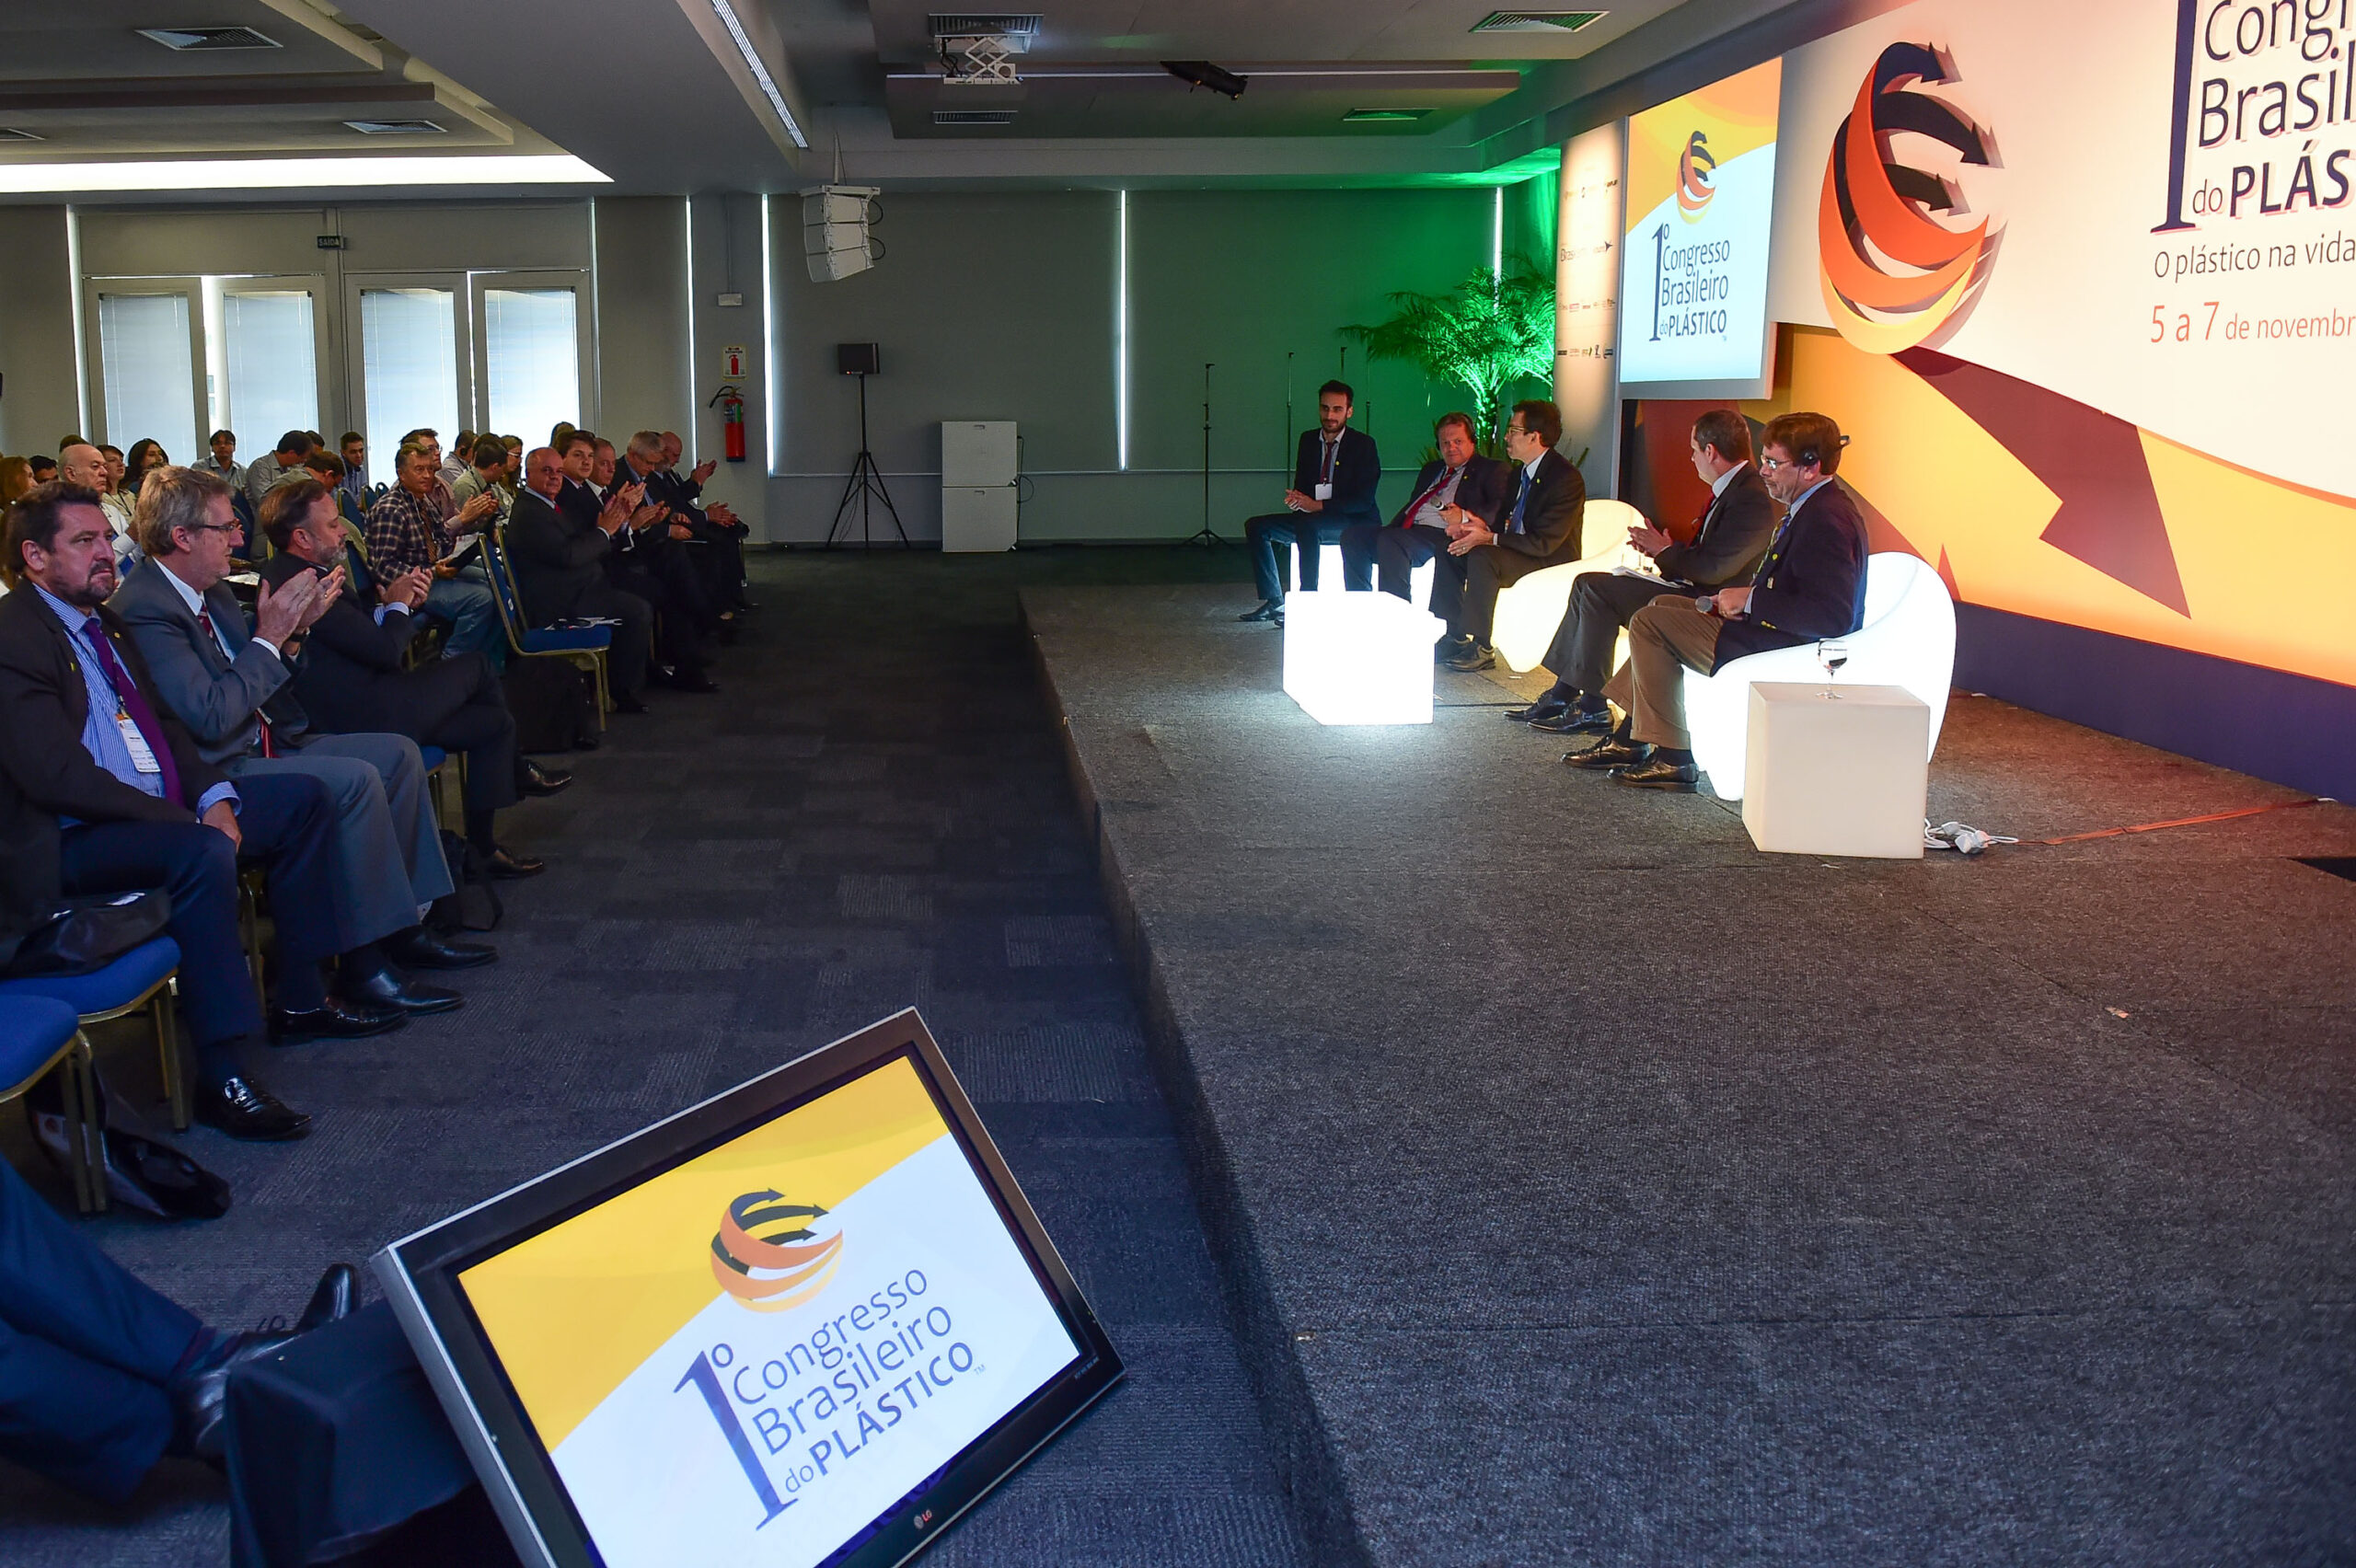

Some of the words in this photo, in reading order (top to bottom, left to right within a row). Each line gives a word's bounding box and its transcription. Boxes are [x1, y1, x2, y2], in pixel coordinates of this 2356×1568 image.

[2199, 40, 2356, 147] Brasil
[2192, 179, 2223, 213] do
[2230, 139, 2351, 217] PLÁS
[1661, 269, 1728, 306] Brasileiro
[1663, 239, 1730, 277] Congresso
[2154, 251, 2170, 278] O
[2175, 243, 2260, 283] plástico
[2269, 244, 2296, 268] na
[2305, 230, 2356, 264] vida
[1669, 307, 1727, 337] PLÁSTICO
[2151, 305, 2165, 343] 5
[2176, 313, 2190, 341] a
[2203, 301, 2220, 340] 7
[2225, 313, 2249, 340] de
[733, 1269, 928, 1405] Congresso
[752, 1306, 952, 1456] Brasileiro
[785, 1465, 814, 1493] do
[808, 1342, 974, 1476] PLÁSTICO
